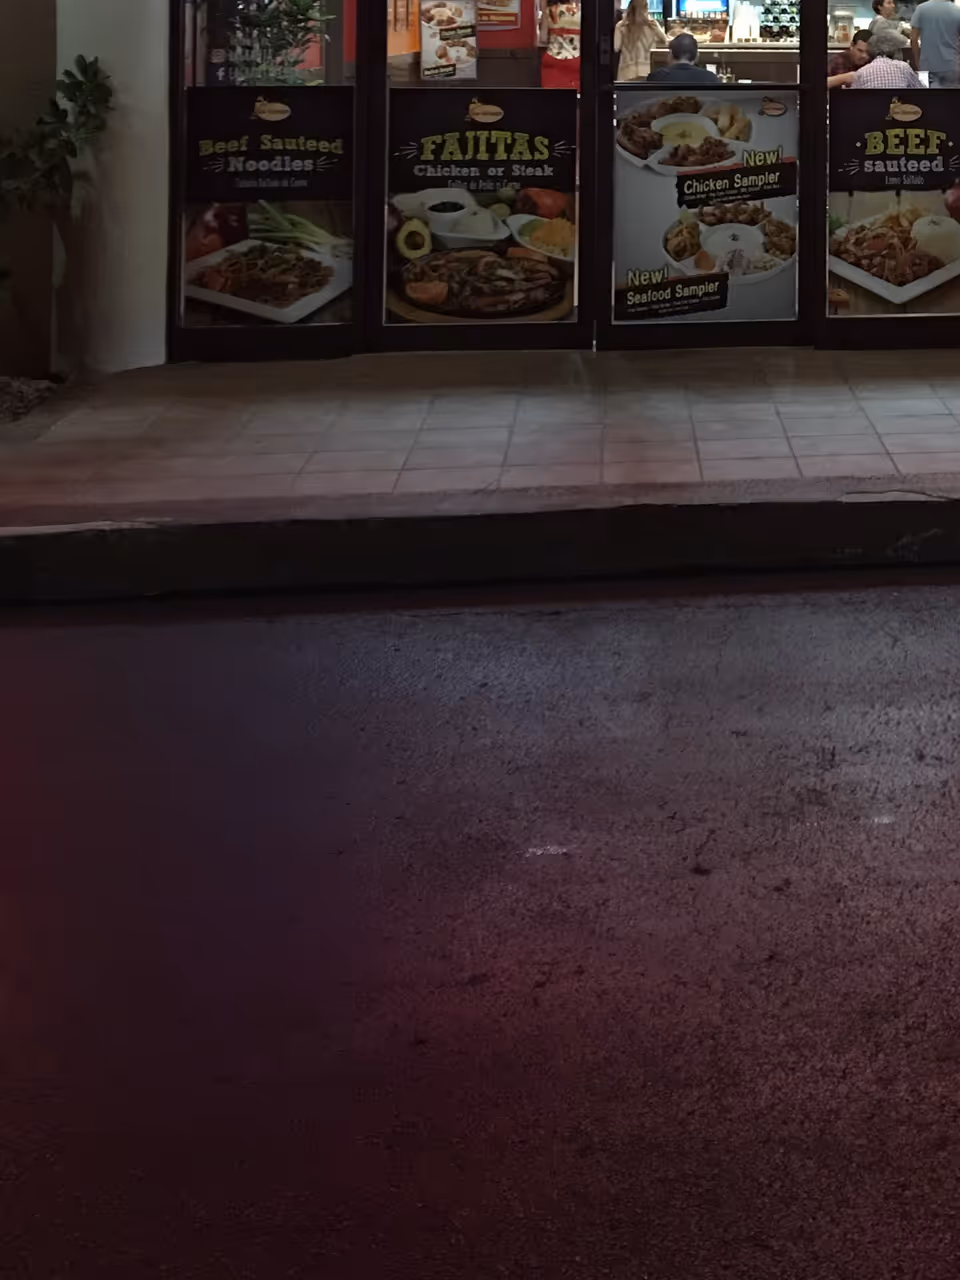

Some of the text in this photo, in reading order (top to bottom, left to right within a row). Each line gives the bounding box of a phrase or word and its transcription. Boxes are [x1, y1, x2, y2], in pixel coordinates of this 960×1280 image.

[198, 134, 345, 157] Beef Sauteed
[419, 129, 551, 161] FAJITAS
[864, 128, 947, 155] BEEF
[226, 156, 315, 172] Noodles
[743, 144, 783, 168] New!
[863, 156, 945, 173] sauteed
[413, 164, 554, 177] Chicken or Steak
[683, 178, 730, 195] Chicken
[733, 171, 781, 189] Sampler
[627, 265, 669, 287] New!
[626, 287, 672, 306] Seafood
[674, 281, 720, 298] Sampler
